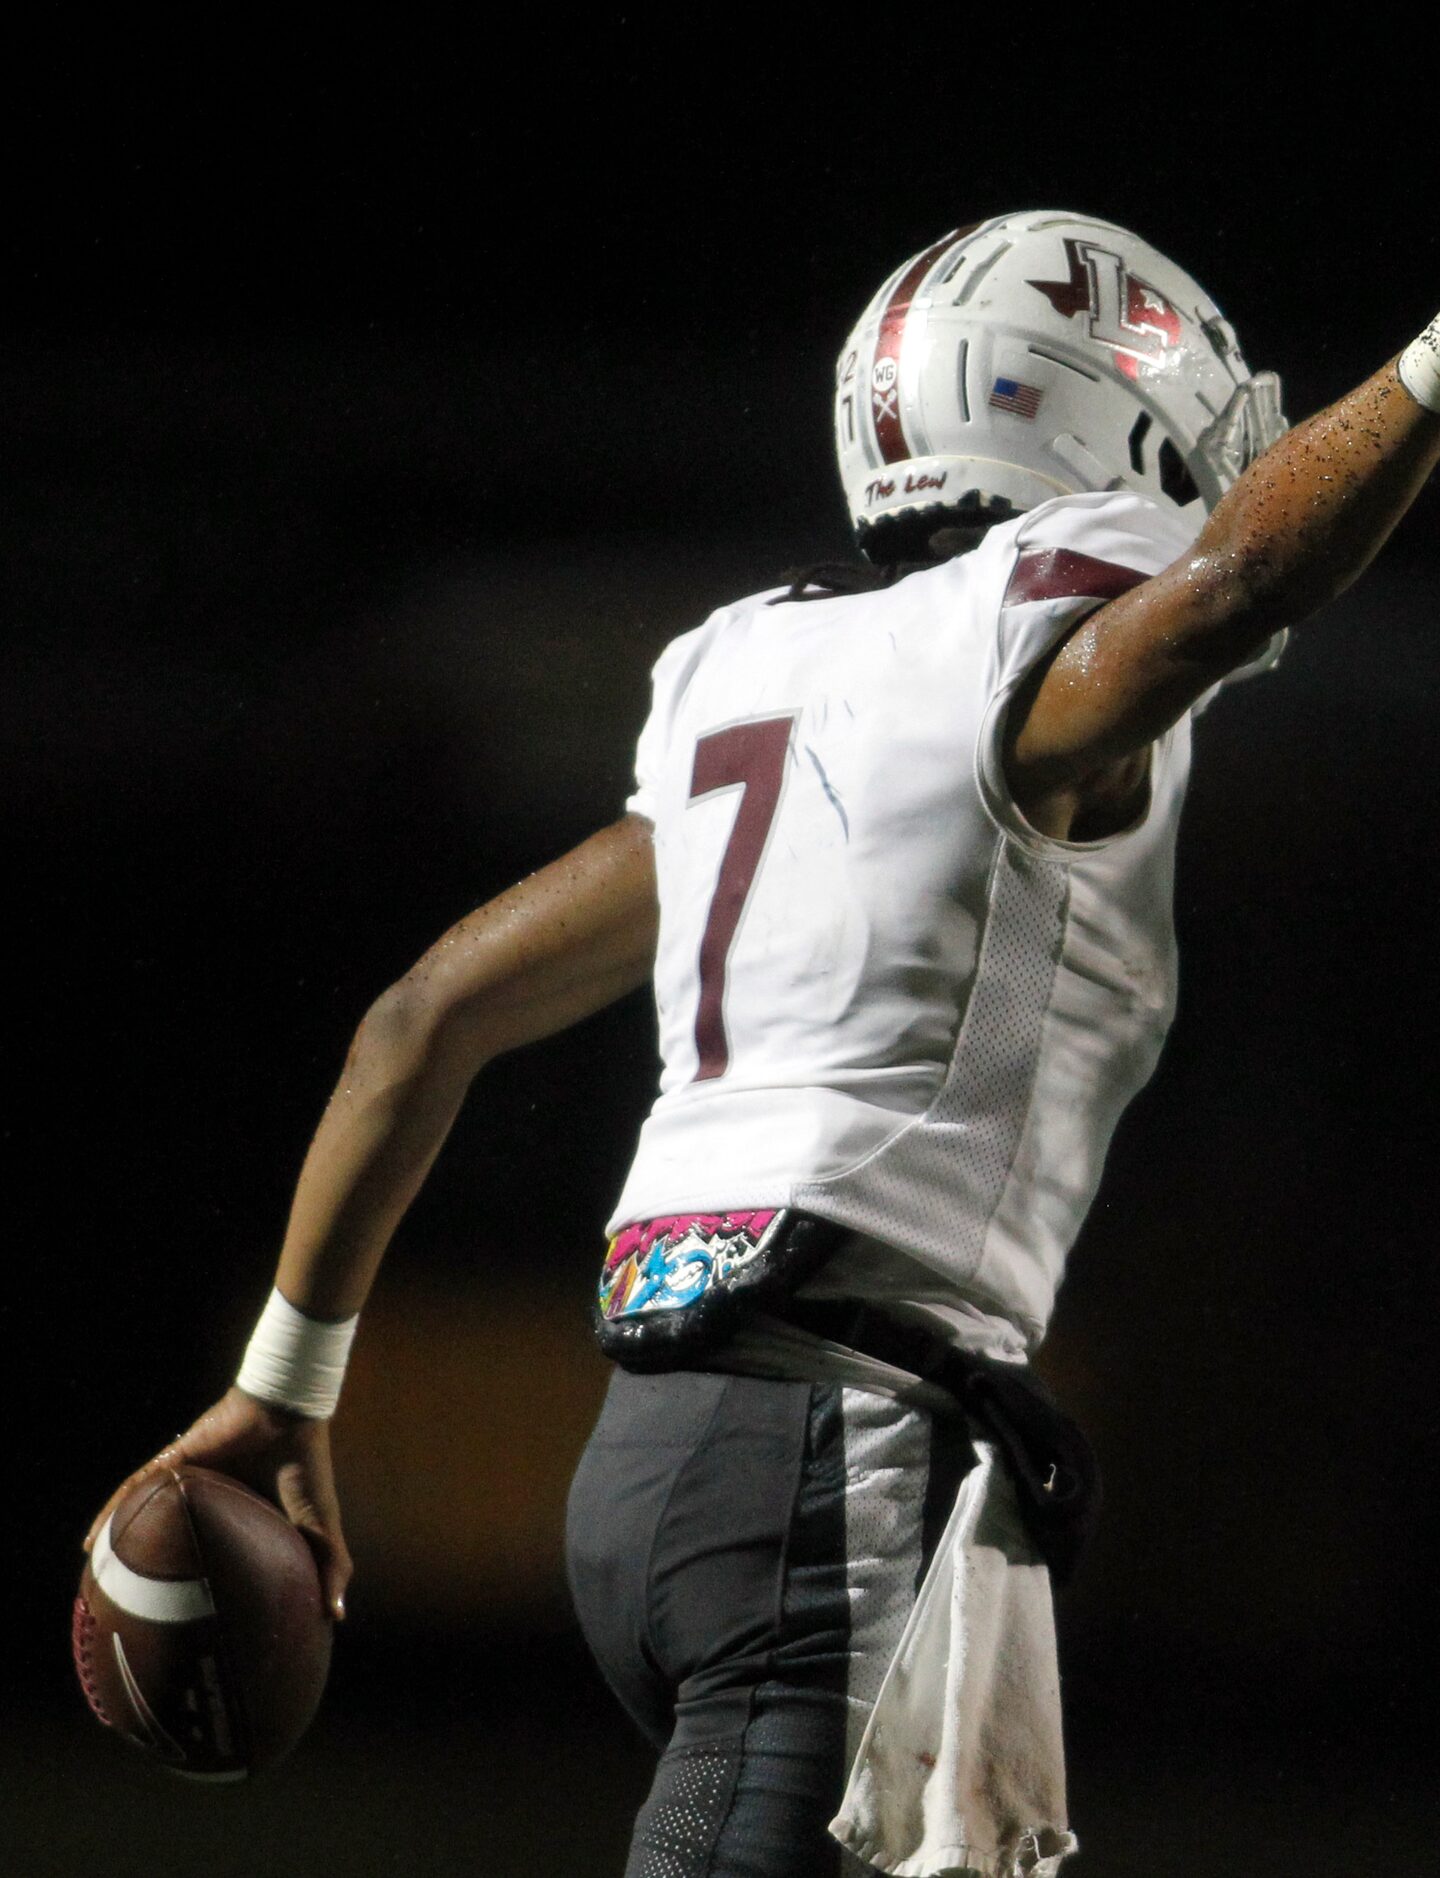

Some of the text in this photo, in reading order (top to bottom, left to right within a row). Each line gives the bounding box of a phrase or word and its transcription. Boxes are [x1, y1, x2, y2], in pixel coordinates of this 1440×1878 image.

[874, 365, 894, 383] WG
[864, 478, 896, 506] The
[687, 707, 802, 1084] 7
